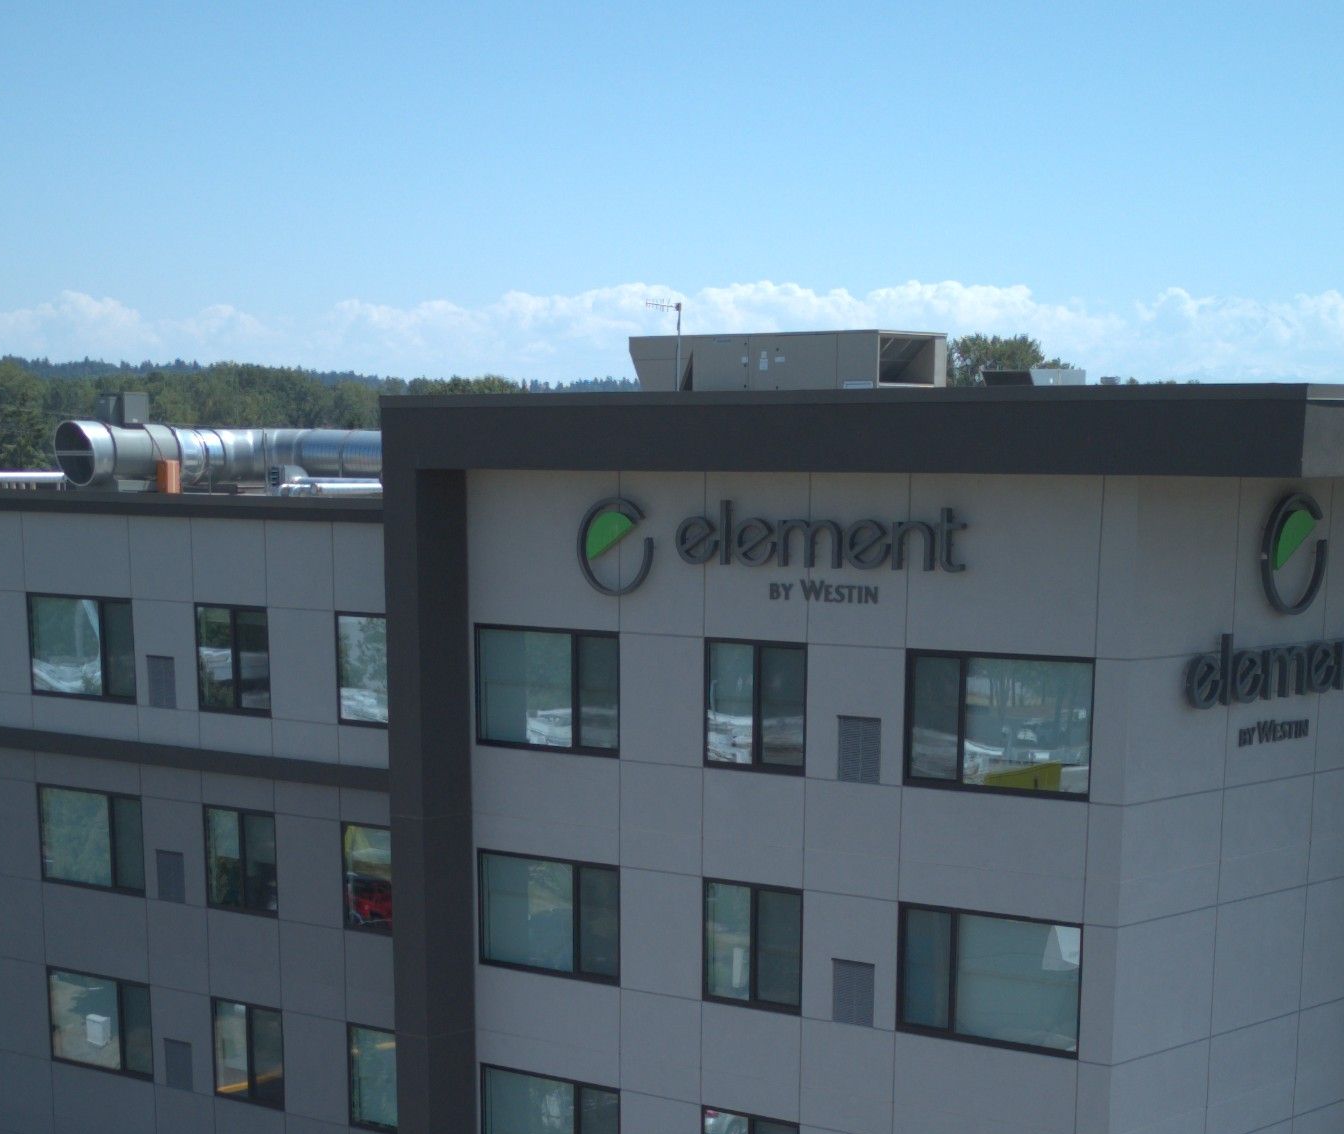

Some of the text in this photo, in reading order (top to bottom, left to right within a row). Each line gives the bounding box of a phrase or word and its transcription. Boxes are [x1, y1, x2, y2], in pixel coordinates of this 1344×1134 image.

[675, 499, 968, 573] element
[769, 583, 793, 601] BY
[1238, 726, 1255, 747] BY
